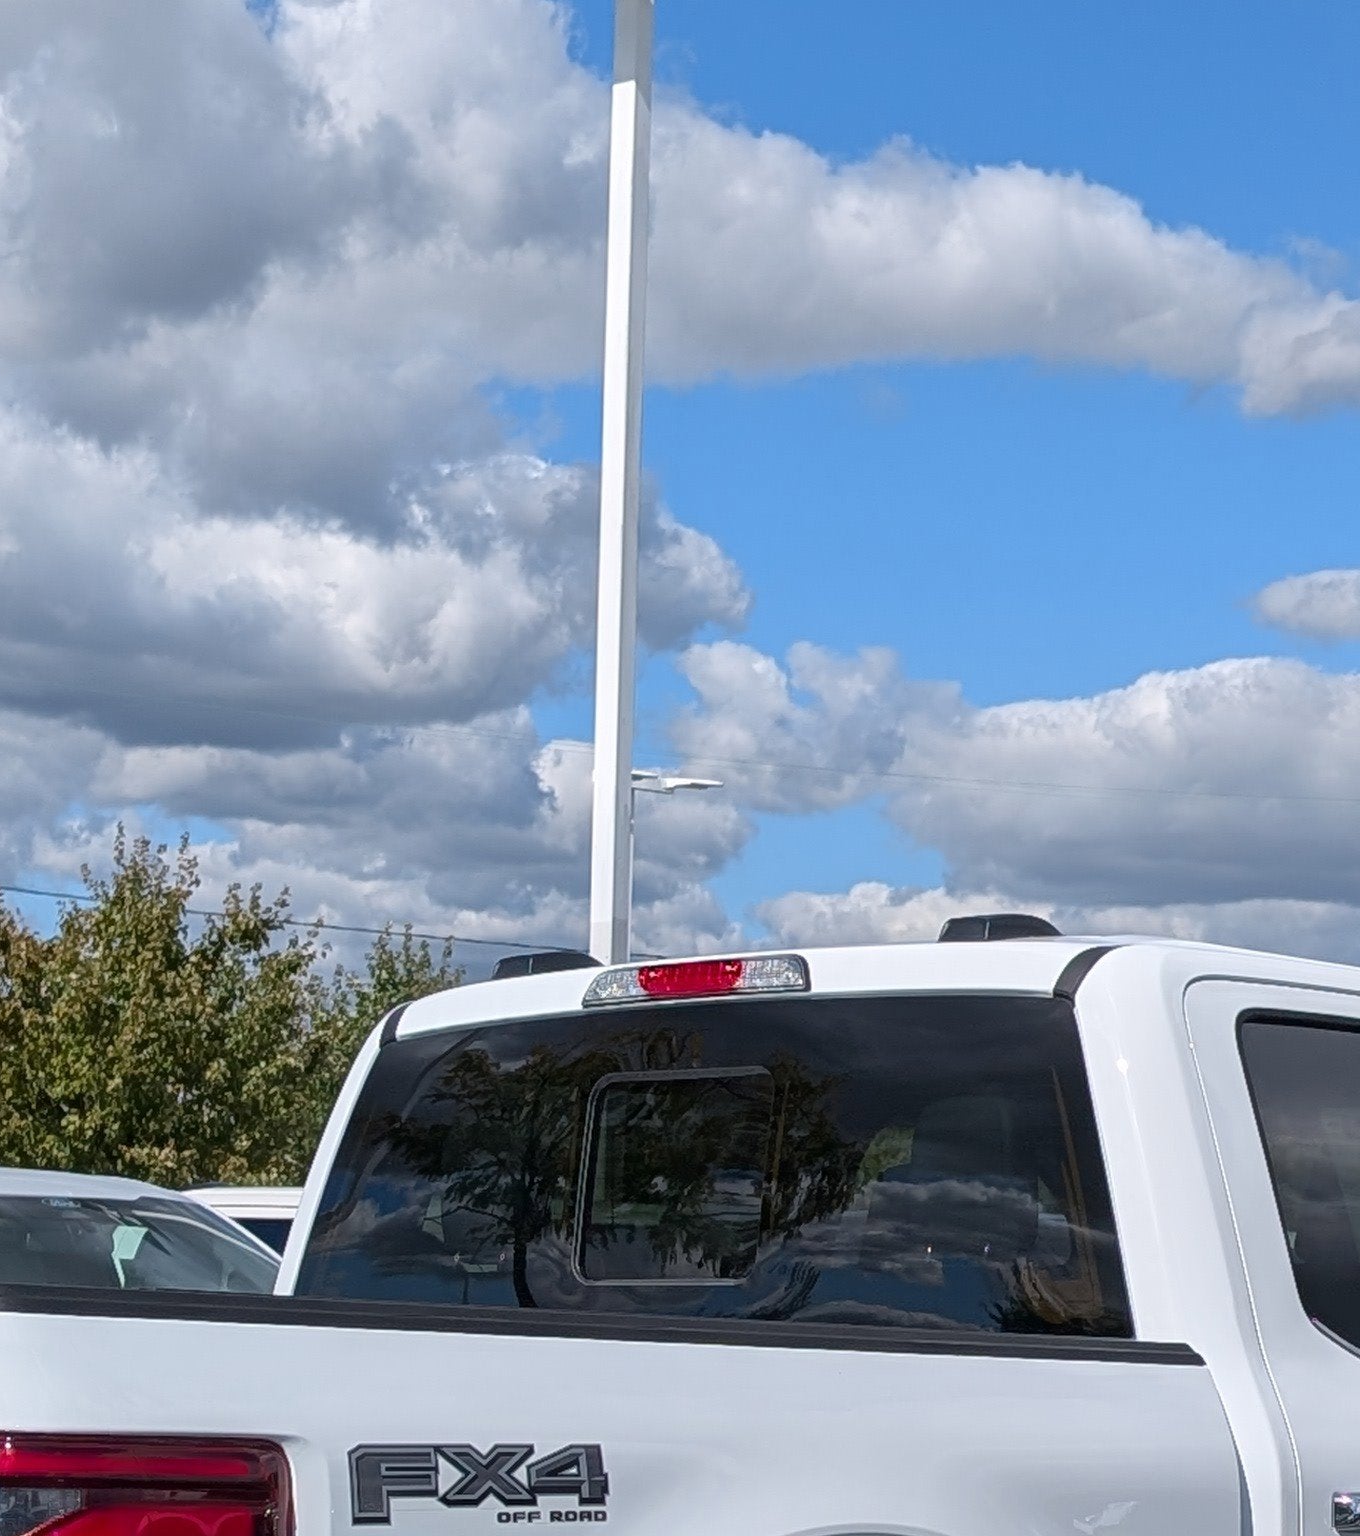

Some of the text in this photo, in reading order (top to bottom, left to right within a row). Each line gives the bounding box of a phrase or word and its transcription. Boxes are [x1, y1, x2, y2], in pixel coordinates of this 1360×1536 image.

[347, 1443, 609, 1526] FX4
[496, 1510, 608, 1524] OFF ROAD
